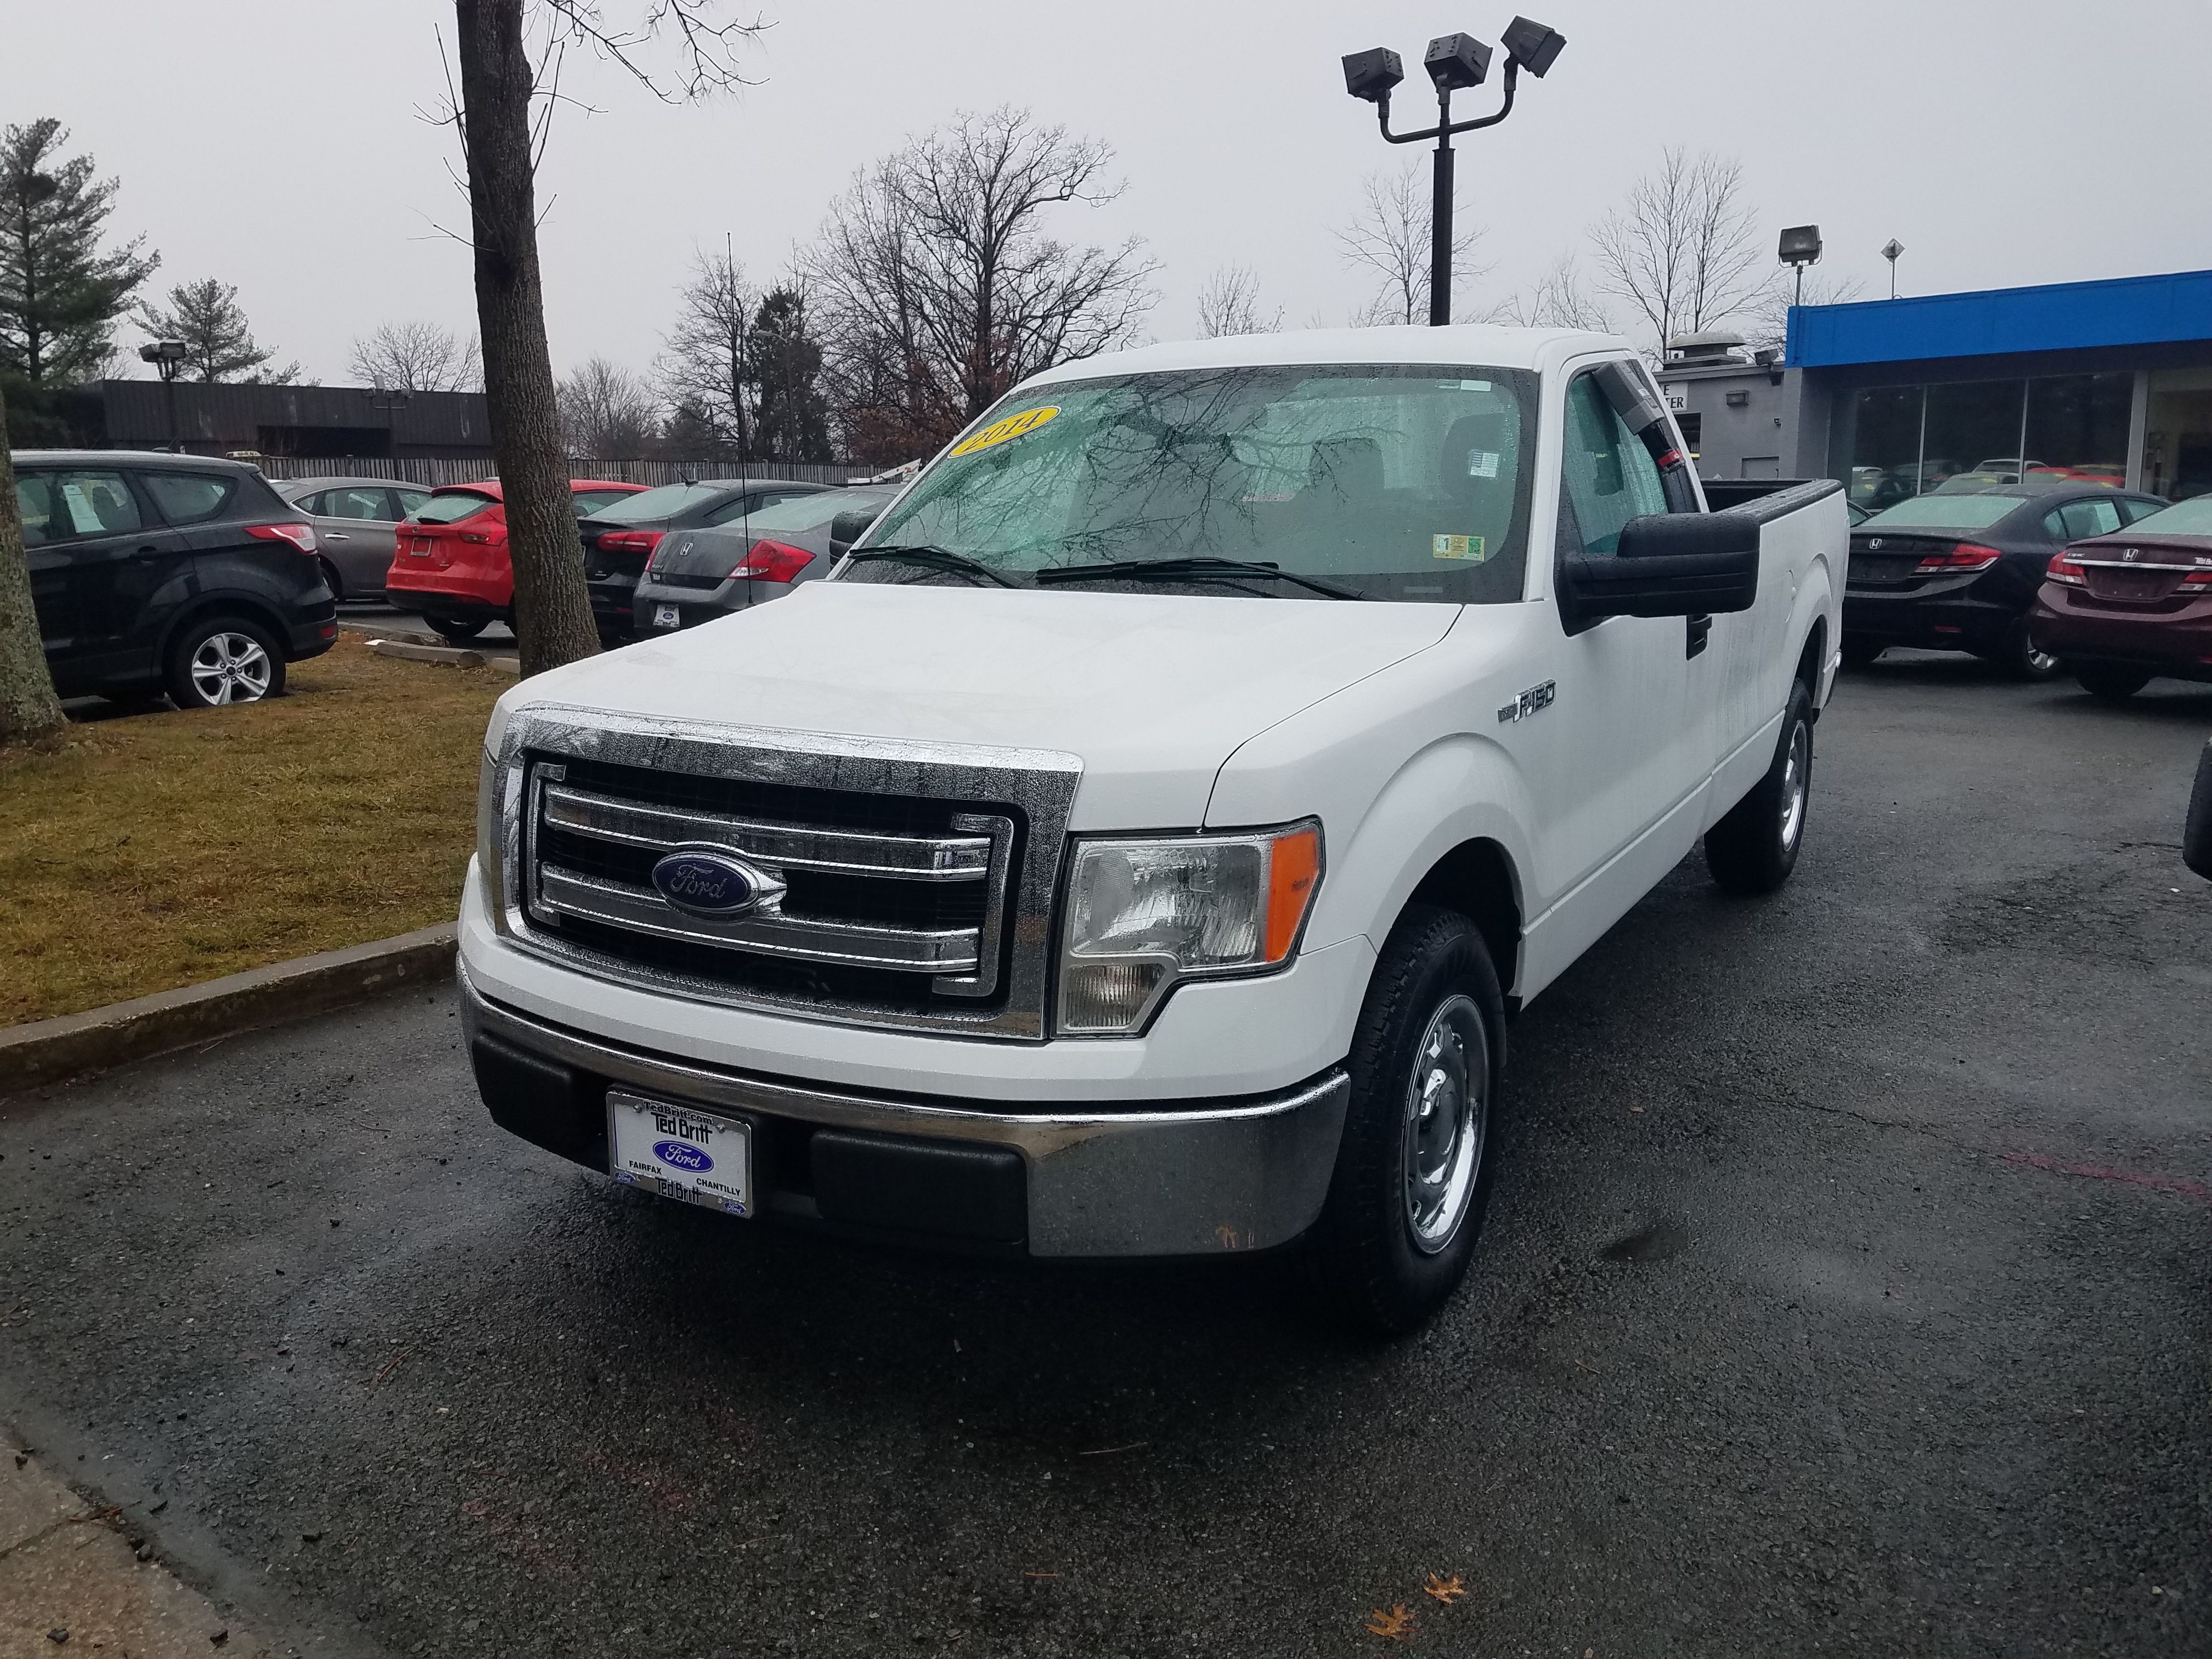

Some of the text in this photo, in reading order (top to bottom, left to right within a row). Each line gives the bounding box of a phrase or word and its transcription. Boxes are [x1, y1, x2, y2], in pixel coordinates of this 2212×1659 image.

[961, 410, 1045, 453] 2014
[669, 864, 727, 899] Ford
[644, 1101, 714, 1125] TedBritt.com
[650, 1111, 713, 1144] Ted Britt
[629, 1160, 662, 1175] FAIRFAX
[665, 1145, 701, 1169] Ford
[654, 1176, 703, 1205] Ted Britt
[696, 1177, 741, 1197] CHANTILLY
[727, 1203, 742, 1214] Ford
